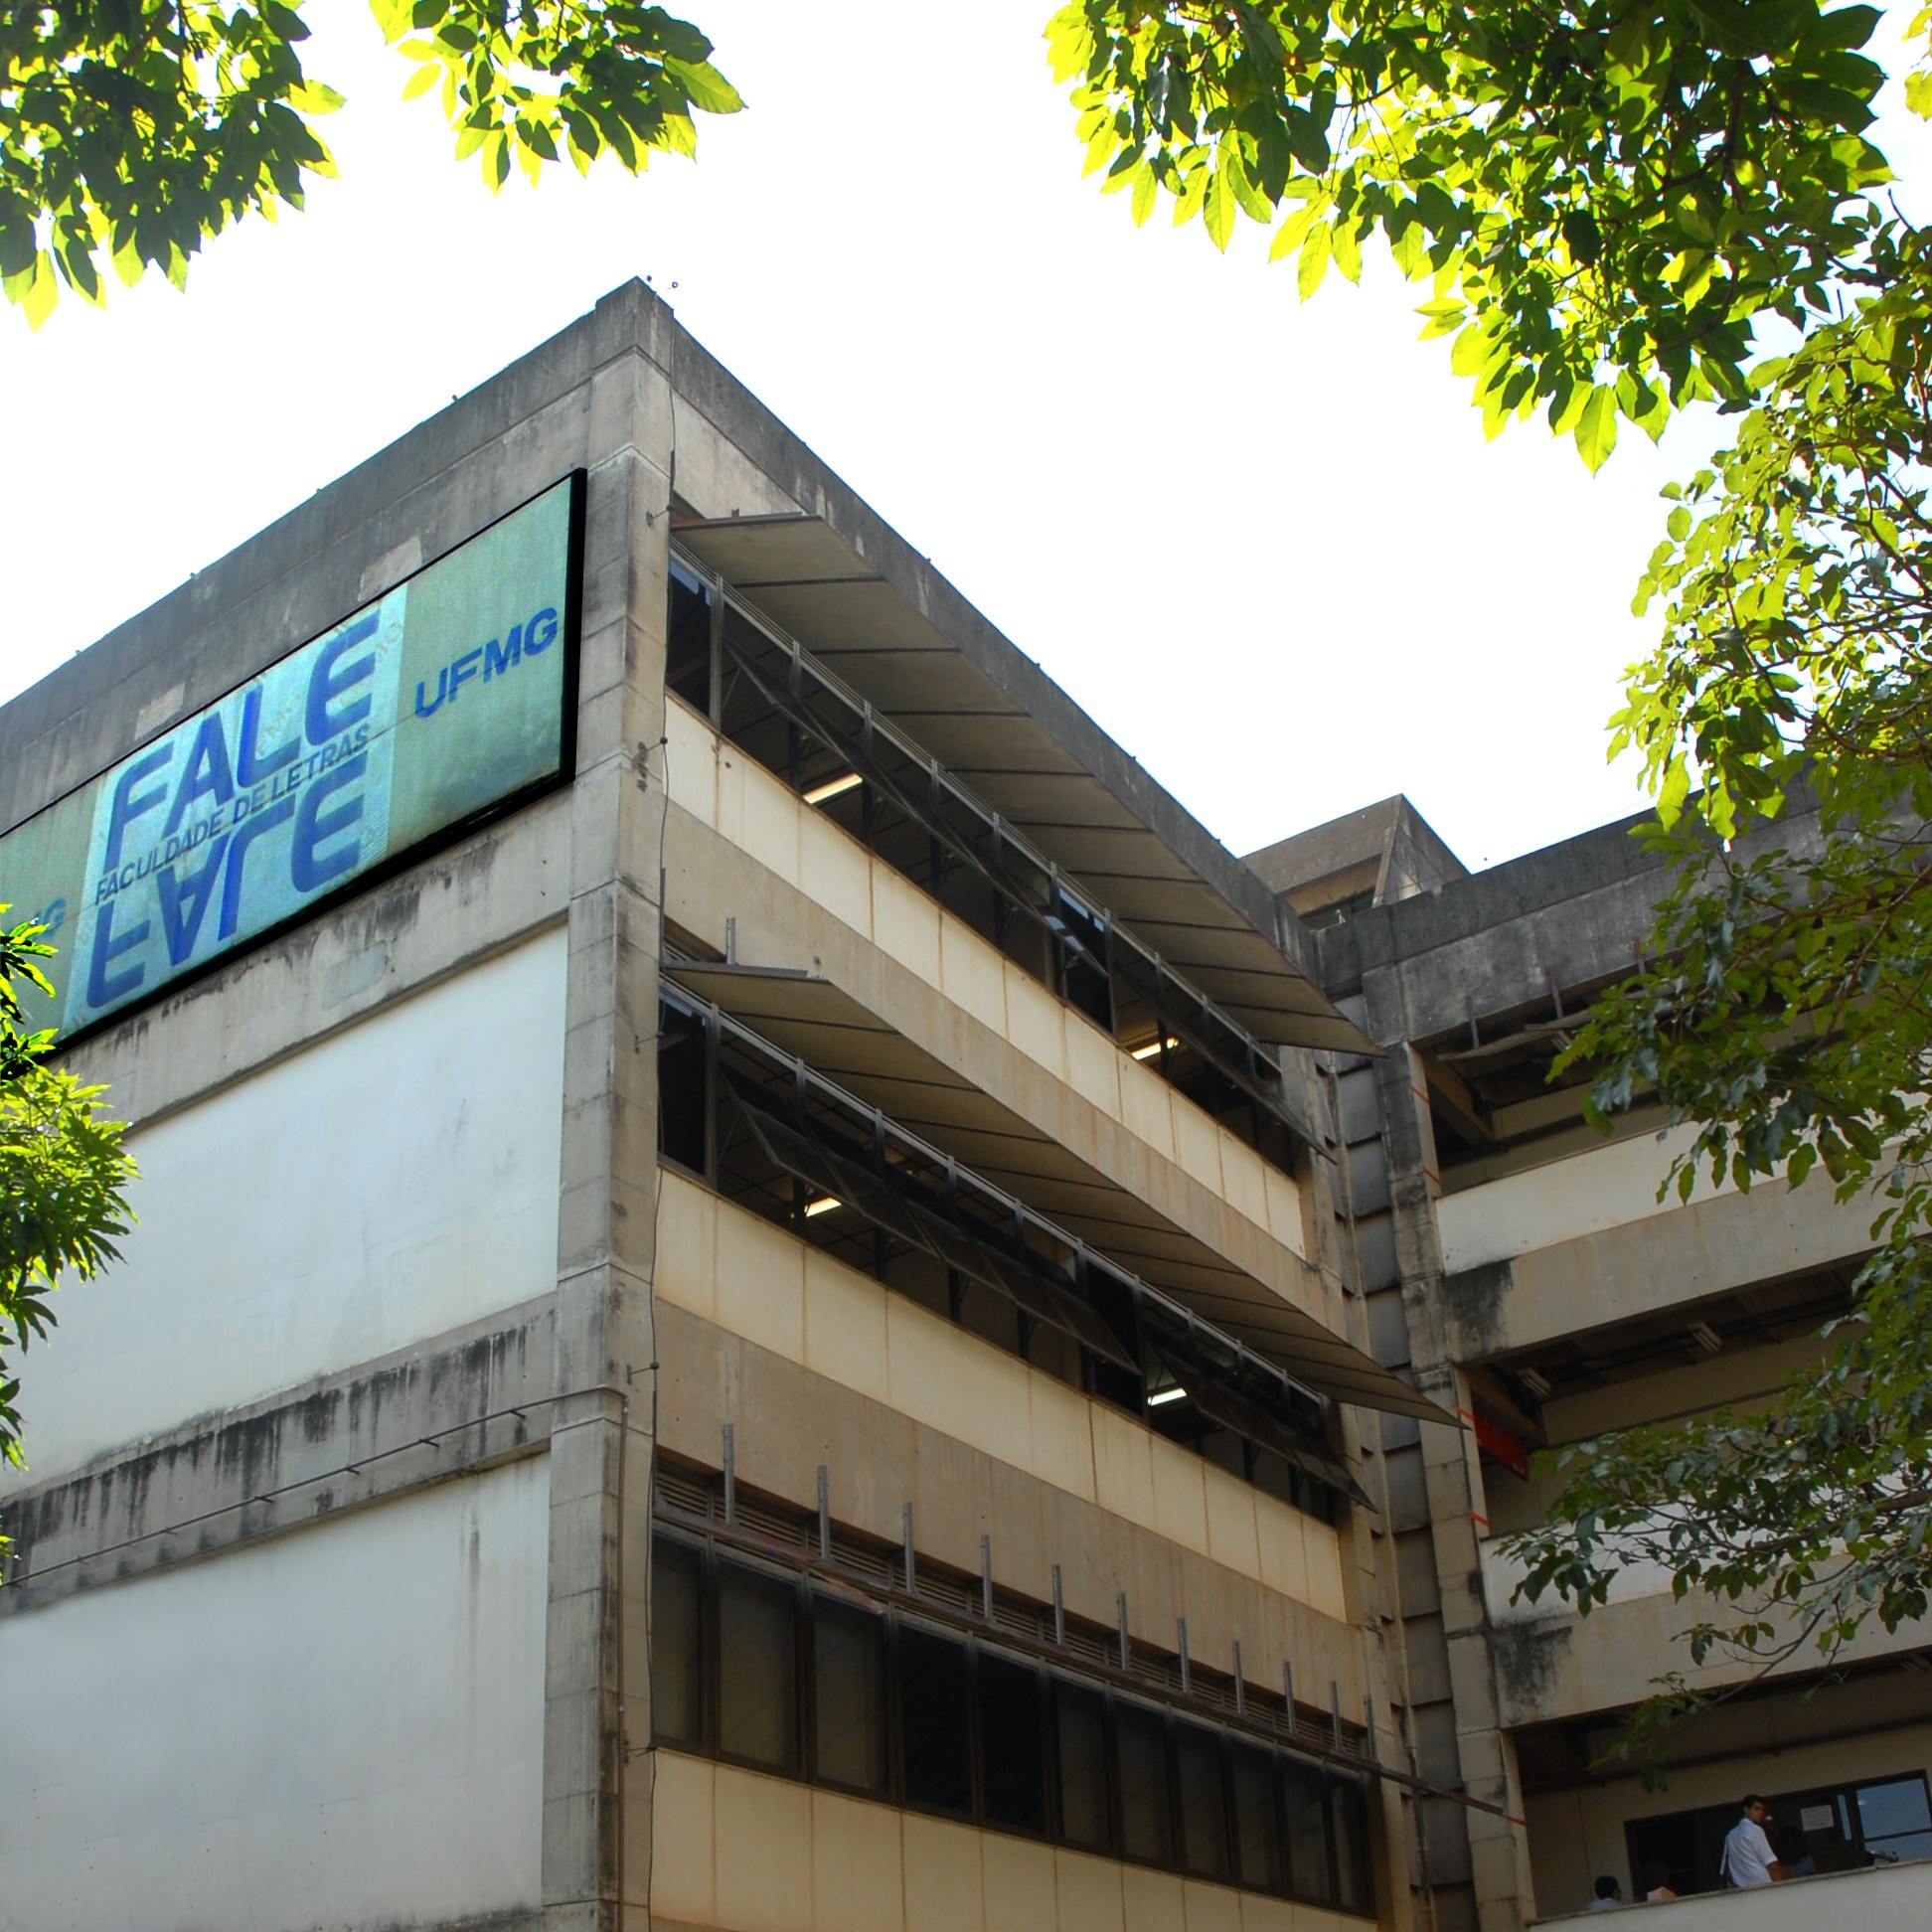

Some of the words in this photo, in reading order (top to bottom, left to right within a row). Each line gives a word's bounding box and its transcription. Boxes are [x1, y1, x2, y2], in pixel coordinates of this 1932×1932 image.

[104, 610, 380, 871] FALE
[414, 607, 559, 719] UFMG
[94, 809, 227, 906] FACULDADE
[233, 785, 268, 826] DE
[273, 724, 371, 805] LETRAS
